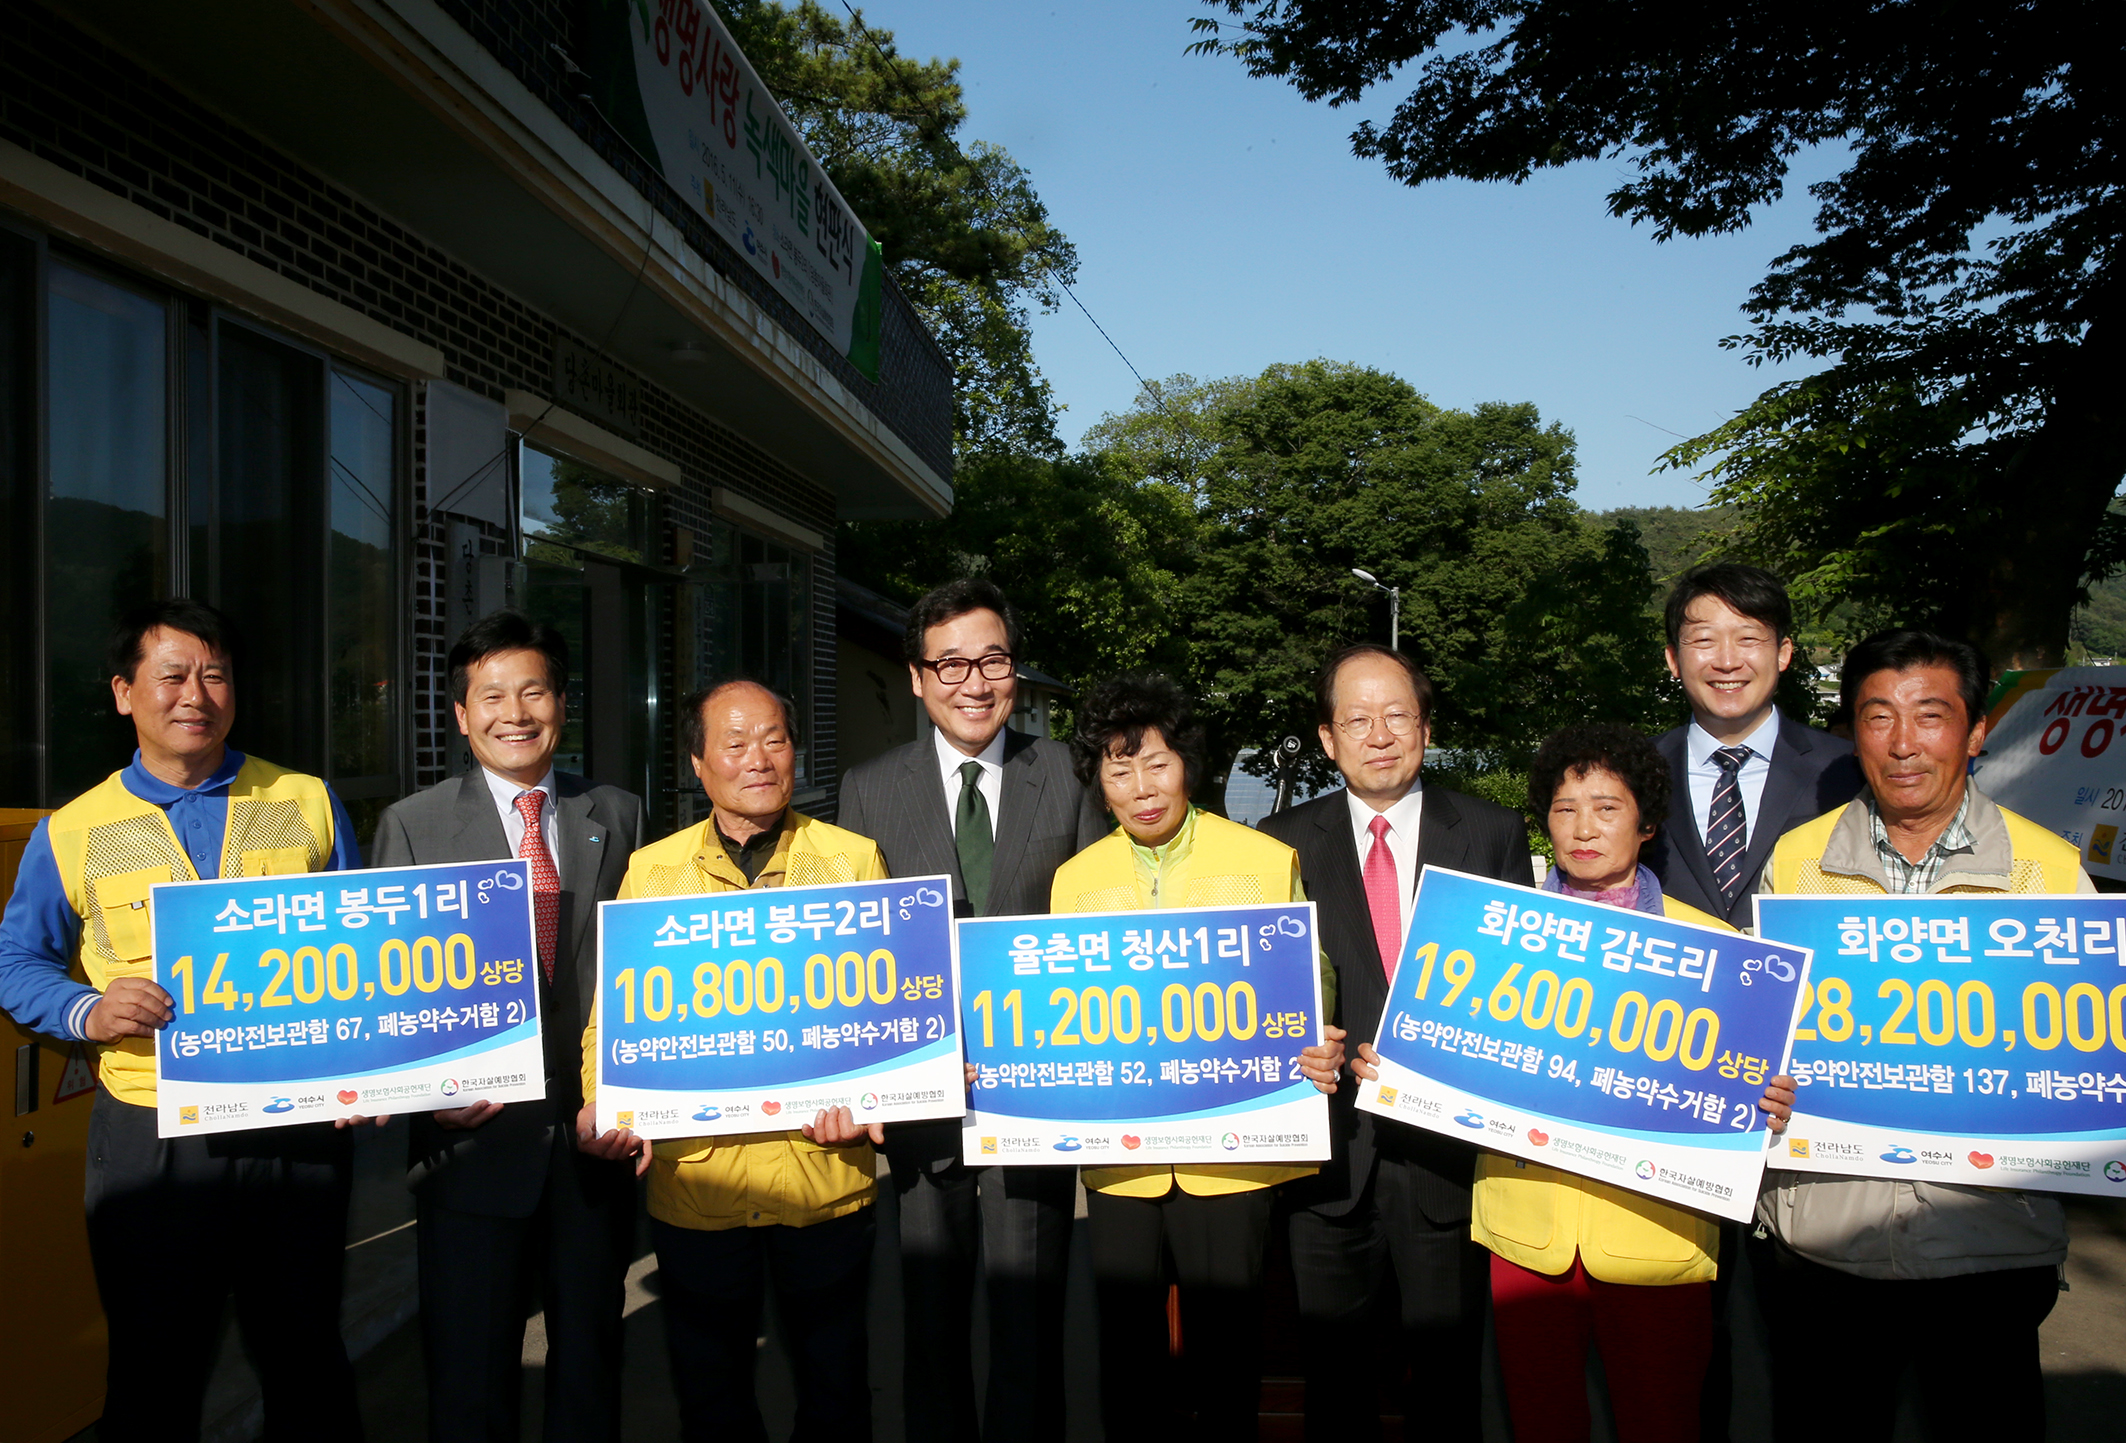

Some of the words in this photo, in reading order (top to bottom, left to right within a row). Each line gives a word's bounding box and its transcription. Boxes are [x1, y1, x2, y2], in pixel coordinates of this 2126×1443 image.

[744, 88, 810, 237] 녹색마을
[815, 182, 854, 286] 현판식
[2039, 686, 2126, 758] 생명
[2074, 787, 2100, 807] 일시
[2101, 788, 2126, 811] 20
[213, 891, 326, 934] 소라면
[335, 880, 468, 929] 봉두1리
[653, 907, 756, 948] 소라면
[765, 897, 891, 943] 봉두2리
[1008, 930, 1112, 975] 율촌면
[1121, 925, 1250, 971] 청산1리
[1477, 900, 1593, 962] 화양면
[1601, 926, 1718, 992] 감도리
[1837, 917, 1972, 963] 화양면
[1984, 918, 2126, 967] 오천리
[171, 934, 476, 1014] 14,200,000
[480, 959, 524, 985] 상당
[615, 948, 897, 1024] 10,800,000
[901, 975, 944, 1000] 상당
[973, 980, 1258, 1049] 11,200,000
[1262, 1011, 1307, 1038] 상당
[1414, 942, 1720, 1071] 19,600,000
[1717, 1050, 1769, 1085] 상당
[170, 1019, 329, 1059] (농약안전보관함
[336, 1017, 371, 1041] 67,
[378, 1002, 499, 1037] 폐농약수거함
[507, 999, 527, 1024] 2)
[612, 1030, 756, 1065] (농약안전보관함
[762, 1029, 795, 1053] 50,
[801, 1017, 920, 1050] 폐농약수거함
[926, 1014, 946, 1040] 2)
[461, 1073, 526, 1087] 한국자살예방협회
[975, 1061, 1114, 1090] (농약안전보관함
[1121, 1061, 1152, 1087] 52,
[1160, 1055, 1281, 1084] 폐농약수거함
[1289, 1054, 1307, 1082] 2
[1392, 1011, 1544, 1075] (농약안전보관함
[1547, 1054, 1582, 1088] 94,
[1589, 1065, 1726, 1126] 폐농약수거함
[1730, 1104, 1757, 1134] 2)
[1790, 1058, 1955, 1094] 농약안전보관함
[1964, 1068, 2018, 1099] 137,
[298, 1095, 325, 1103] 여수시
[361, 1083, 431, 1098] 생명보험사회공헌재단
[881, 1090, 945, 1102] 한국자살예방협회
[203, 1101, 249, 1115] 전라남도
[725, 1105, 750, 1113] 여수시
[1398, 1103, 1440, 1119] ChollaNamdo
[1400, 1093, 1443, 1113] 전라남도
[204, 1112, 249, 1122] ChollaNamdo
[637, 1108, 680, 1121] 전라남도
[638, 1118, 679, 1127] ChollaNamdo
[1489, 1120, 1516, 1133] 여수시
[1001, 1137, 1041, 1147] 전라남도
[1085, 1137, 1110, 1145] 여수시
[1144, 1135, 1212, 1145] 생명보험사회공헌재단
[1242, 1133, 1308, 1143] 한국자살예방협회
[1552, 1137, 1627, 1165] 생명보험사회공헌재단
[1814, 1142, 1864, 1155] 전라남도
[1815, 1153, 1864, 1162] ChollaNamdo
[1921, 1150, 1953, 1160] 여수시
[1999, 1156, 2091, 1171] 생명보험사회공헌재단
[1659, 1168, 1733, 1197] 한국자살예방협회
